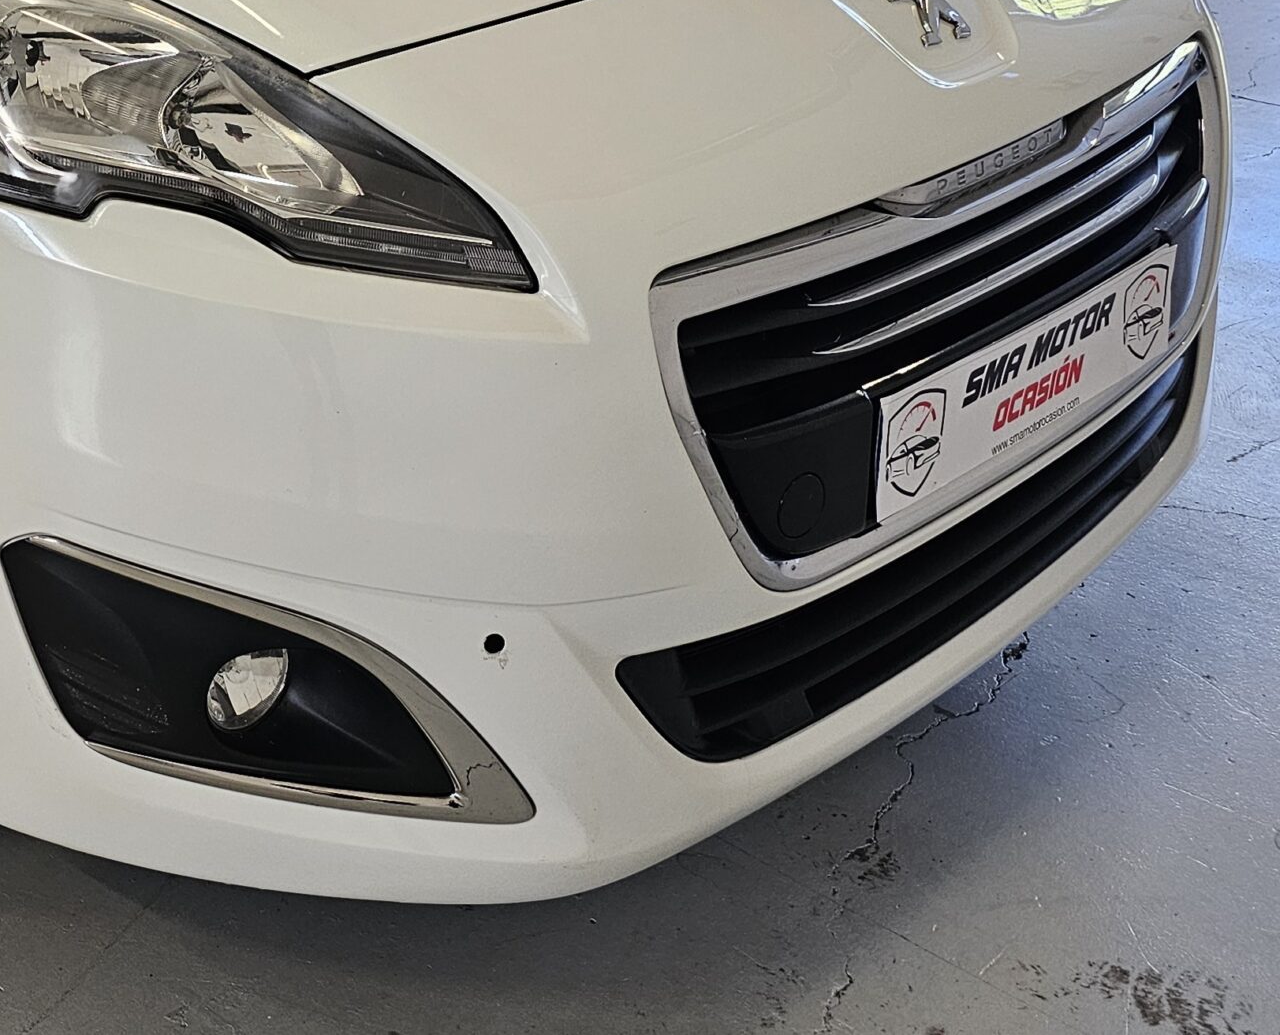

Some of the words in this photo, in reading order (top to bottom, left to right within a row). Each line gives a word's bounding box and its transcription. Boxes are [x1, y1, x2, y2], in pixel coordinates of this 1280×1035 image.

[935, 128, 1053, 195] PEUGEOT
[961, 344, 1027, 408] SMA
[1027, 293, 1116, 371] MOTOR
[992, 354, 1085, 432] OCASIÓN
